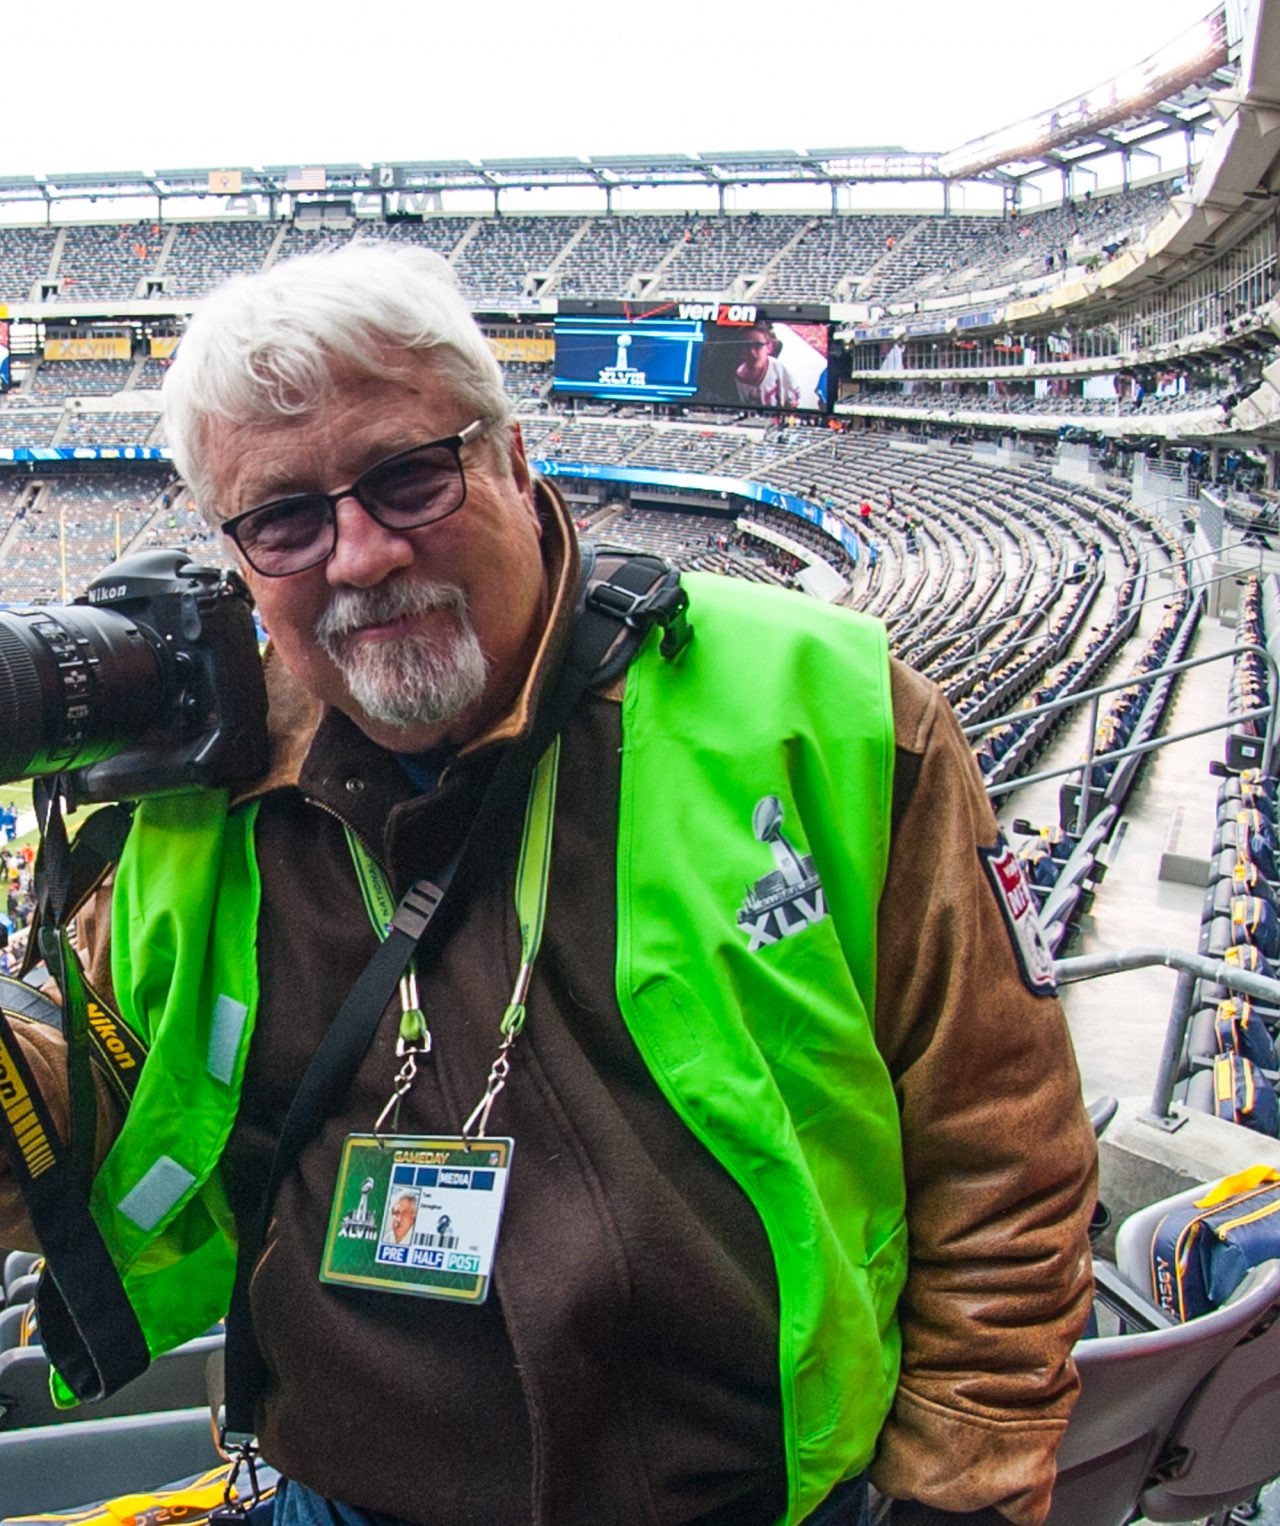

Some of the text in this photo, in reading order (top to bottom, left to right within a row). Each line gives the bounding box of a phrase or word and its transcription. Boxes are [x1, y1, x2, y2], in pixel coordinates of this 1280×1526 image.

[678, 301, 757, 322] verizon
[60, 341, 116, 358] XLVIII
[88, 584, 127, 603] Nikon
[87, 1002, 136, 1070] Nikon
[393, 1151, 449, 1164] GAMEDAY
[440, 1171, 469, 1186] MEDIA
[338, 1222, 377, 1240] XLVIII
[381, 1247, 404, 1262] PRE
[413, 1249, 444, 1267] HALF
[448, 1253, 480, 1271] POST
